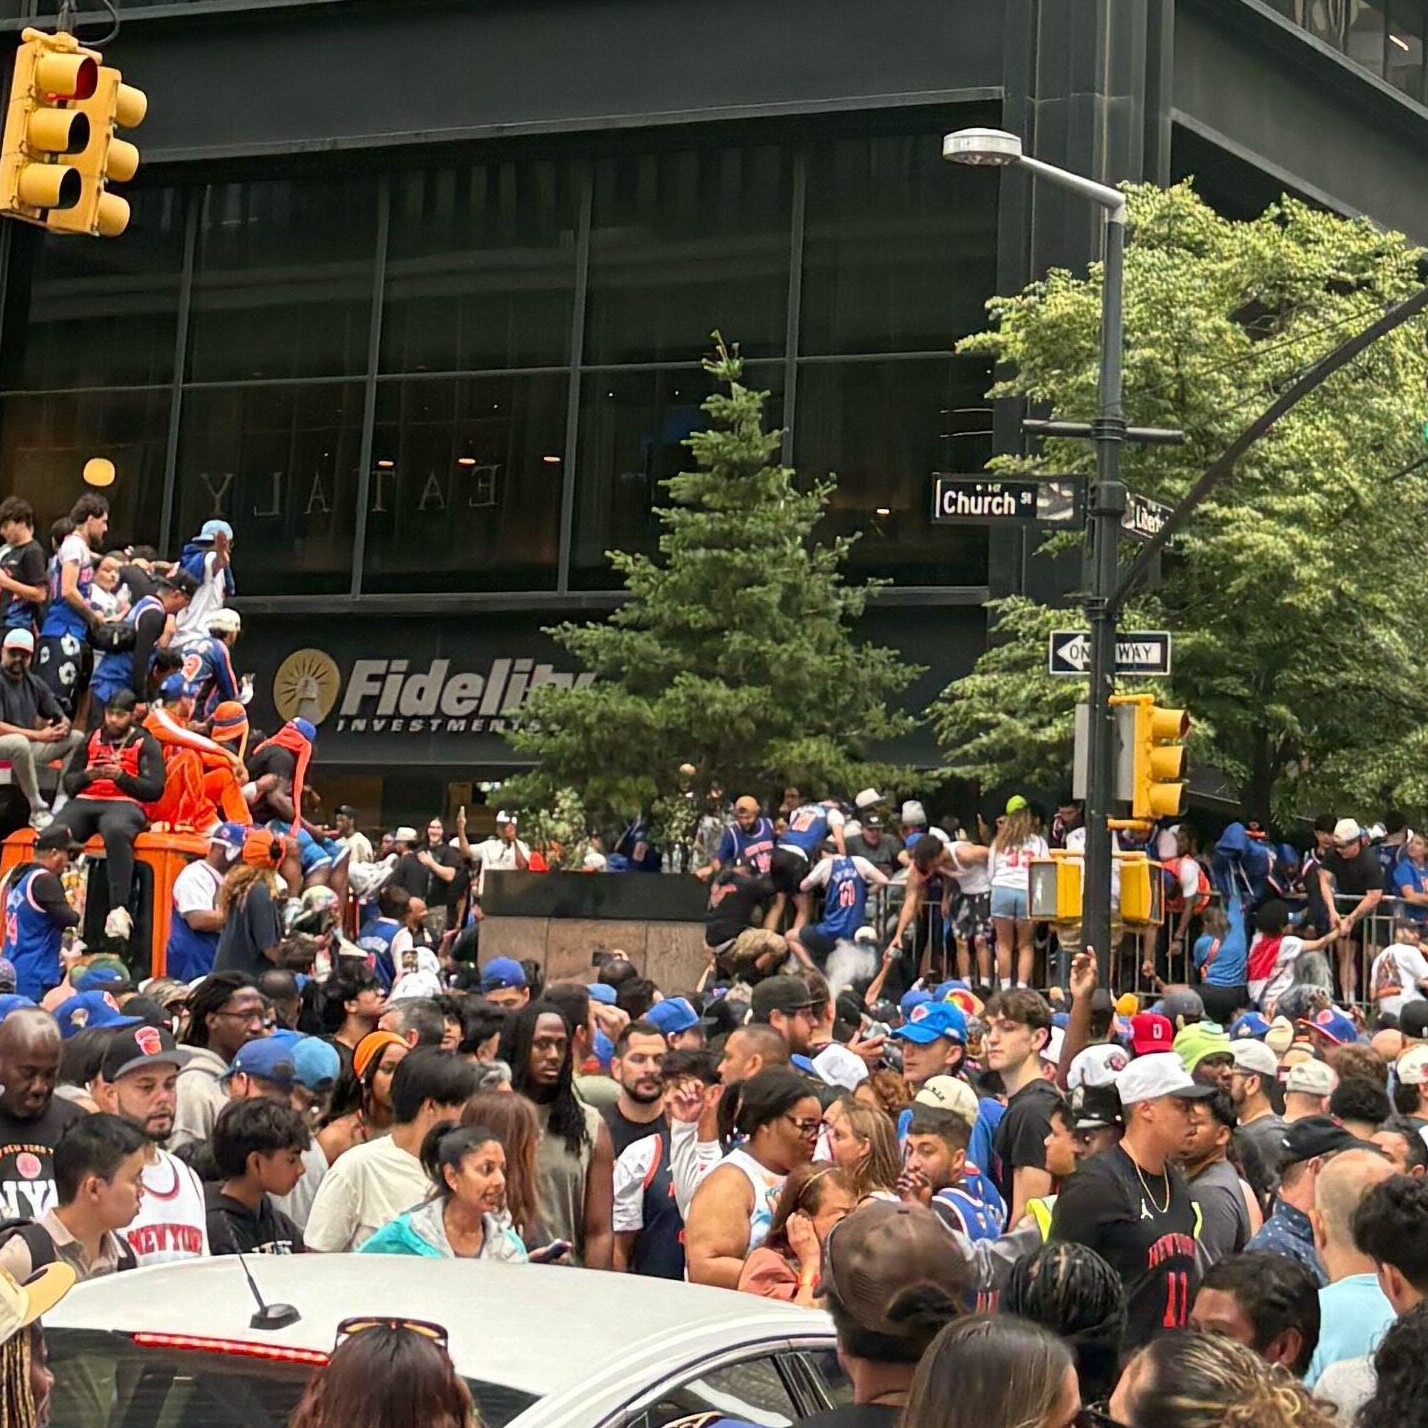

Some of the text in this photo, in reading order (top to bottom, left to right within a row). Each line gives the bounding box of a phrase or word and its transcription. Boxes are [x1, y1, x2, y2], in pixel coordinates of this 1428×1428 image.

[943, 490, 1016, 515] Church
[1117, 645, 1152, 662] WAY
[127, 1224, 169, 1256] NEW
